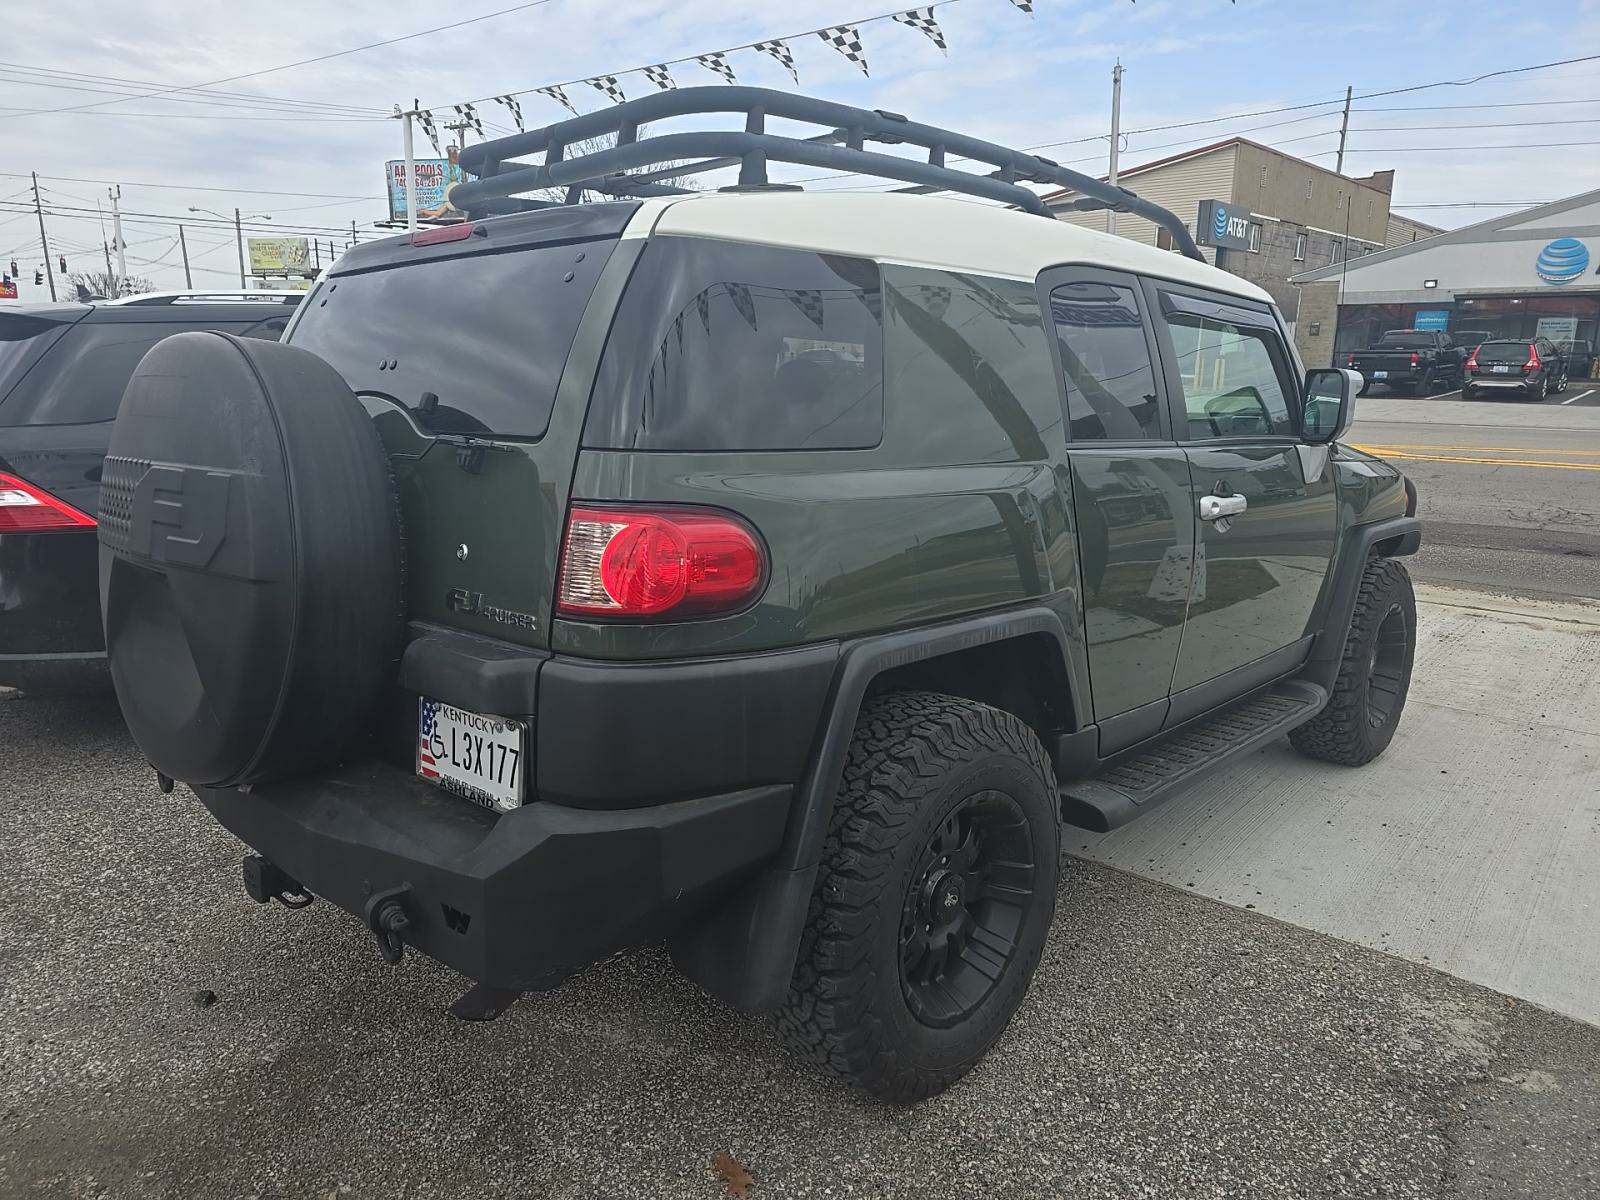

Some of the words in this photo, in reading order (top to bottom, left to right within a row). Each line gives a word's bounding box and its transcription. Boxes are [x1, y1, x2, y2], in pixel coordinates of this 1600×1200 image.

[1226, 216, 1248, 238] AT&T
[443, 706, 496, 735] KENTUCKY
[451, 727, 519, 788] L3X177
[440, 778, 494, 809] ASHLAND
